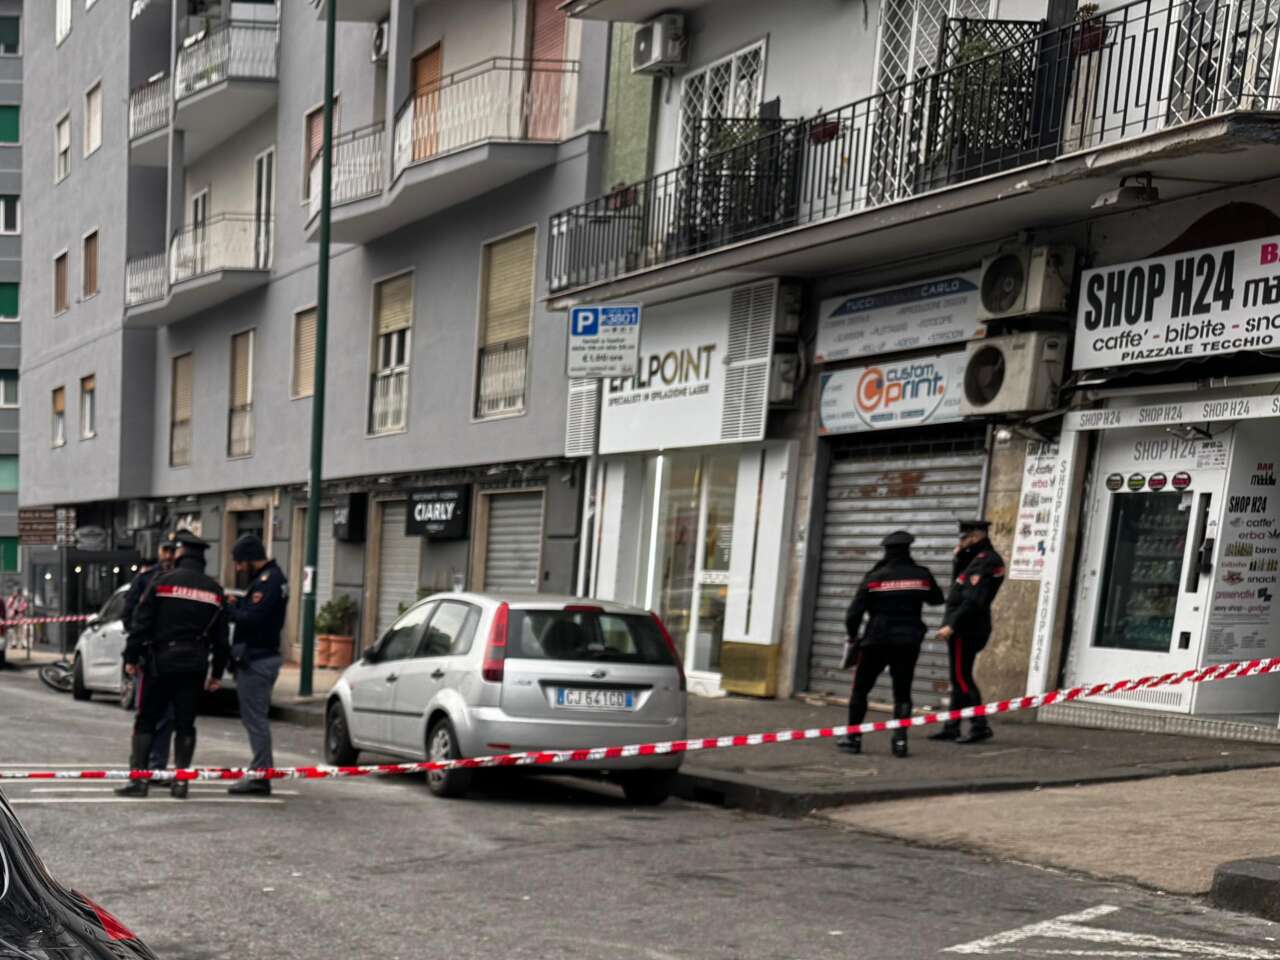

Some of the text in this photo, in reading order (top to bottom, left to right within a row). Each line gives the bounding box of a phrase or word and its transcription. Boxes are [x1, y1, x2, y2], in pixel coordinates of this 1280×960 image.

[1260, 243, 1280, 265] B
[921, 280, 960, 296] CARLO
[1084, 249, 1235, 331] SHOP H24
[1165, 319, 1226, 343] bibite
[1121, 335, 1273, 361] PIAZZALE TECCHIO
[1139, 405, 1183, 423] SHOP H24
[1202, 399, 1250, 418] SHOP H24
[1080, 410, 1121, 427] SHOP H24
[1134, 439, 1169, 461] SHOP
[1170, 439, 1197, 460] H24
[414, 502, 456, 521] CIARLY
[1229, 495, 1267, 513] SHOP H24
